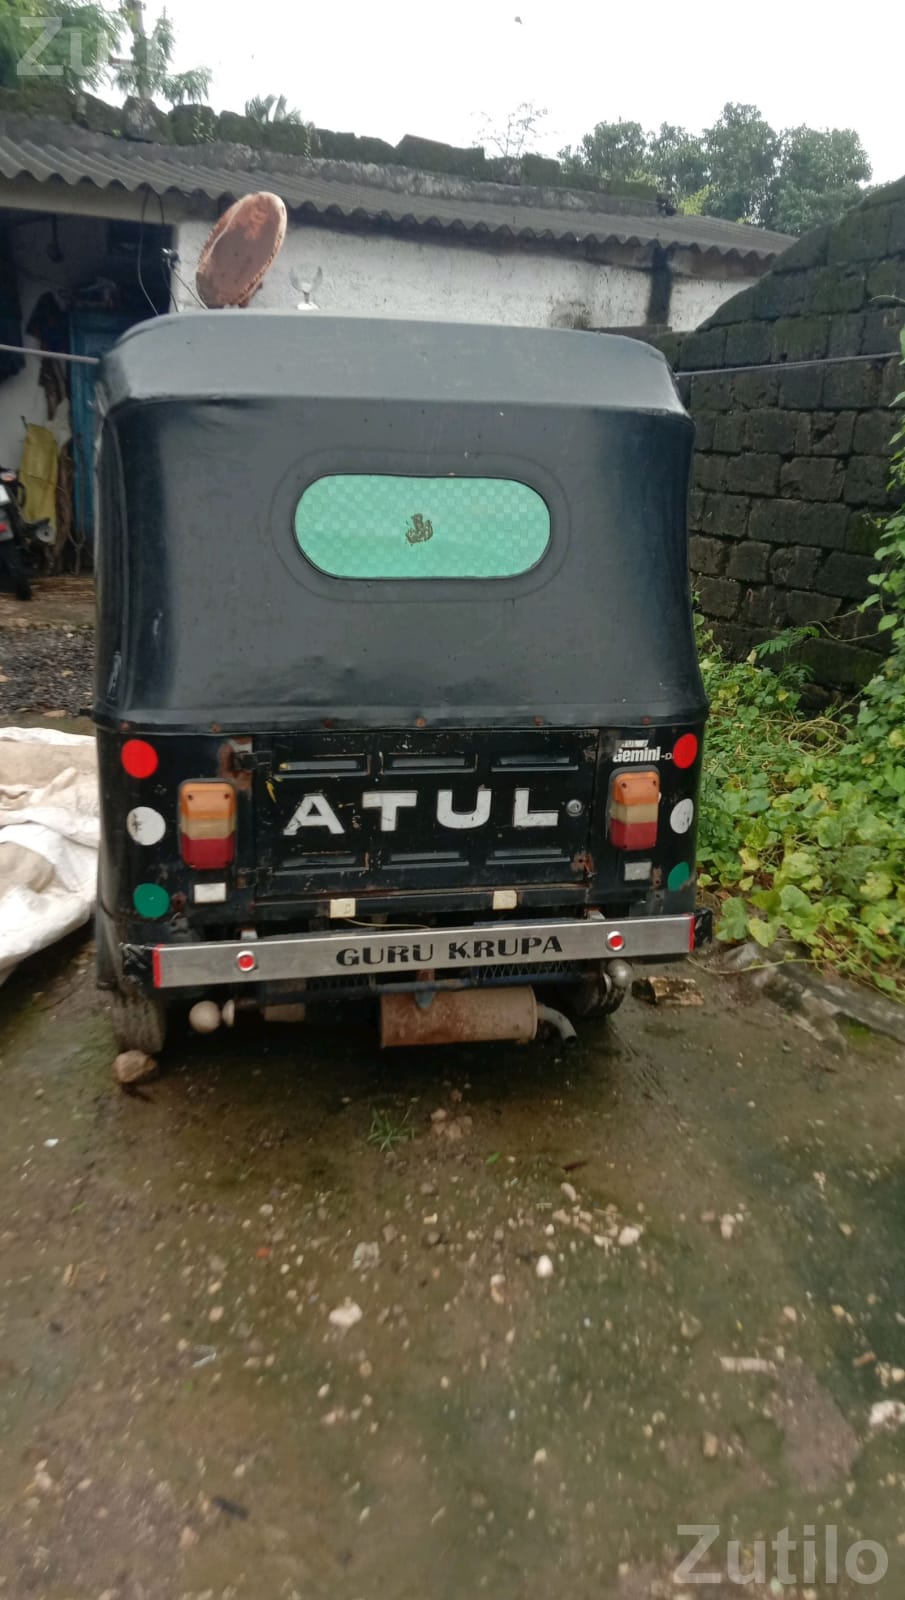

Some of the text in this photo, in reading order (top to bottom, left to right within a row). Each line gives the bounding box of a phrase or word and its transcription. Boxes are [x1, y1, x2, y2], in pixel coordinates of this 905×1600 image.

[283, 787, 559, 836] ATUL
[336, 935, 564, 967] GURU KRUPA
